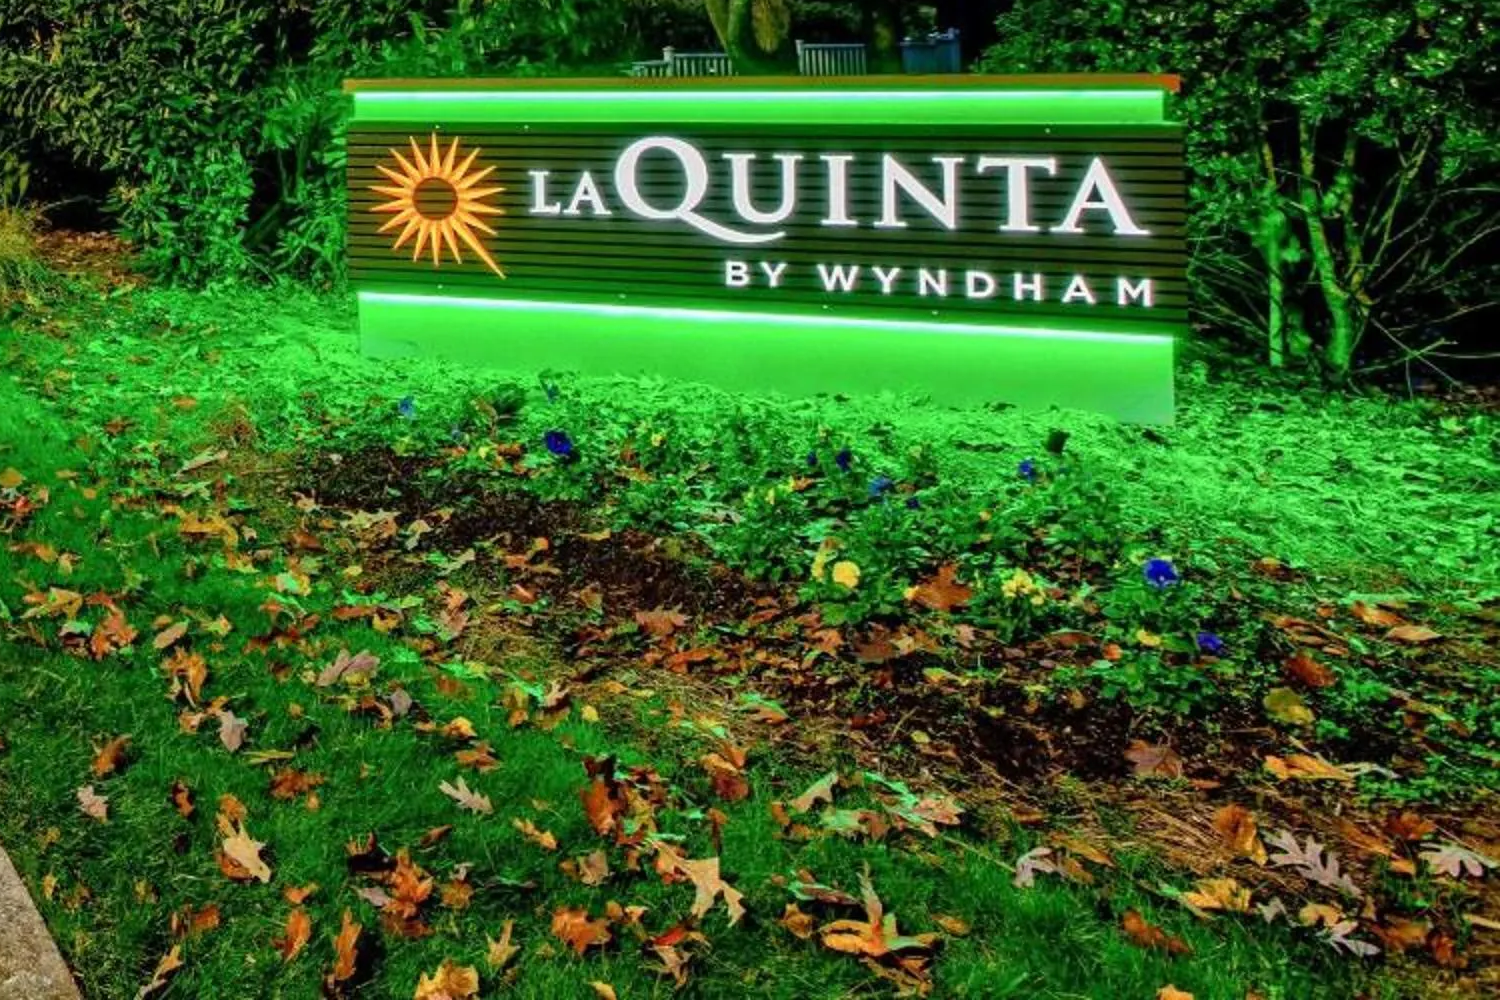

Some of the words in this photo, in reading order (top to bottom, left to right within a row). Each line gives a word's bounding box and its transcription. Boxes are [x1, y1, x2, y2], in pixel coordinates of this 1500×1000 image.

[528, 169, 613, 216] LA
[614, 135, 1152, 244] QUINTA
[725, 259, 787, 288] BY
[817, 263, 1154, 308] WYNDHAM
